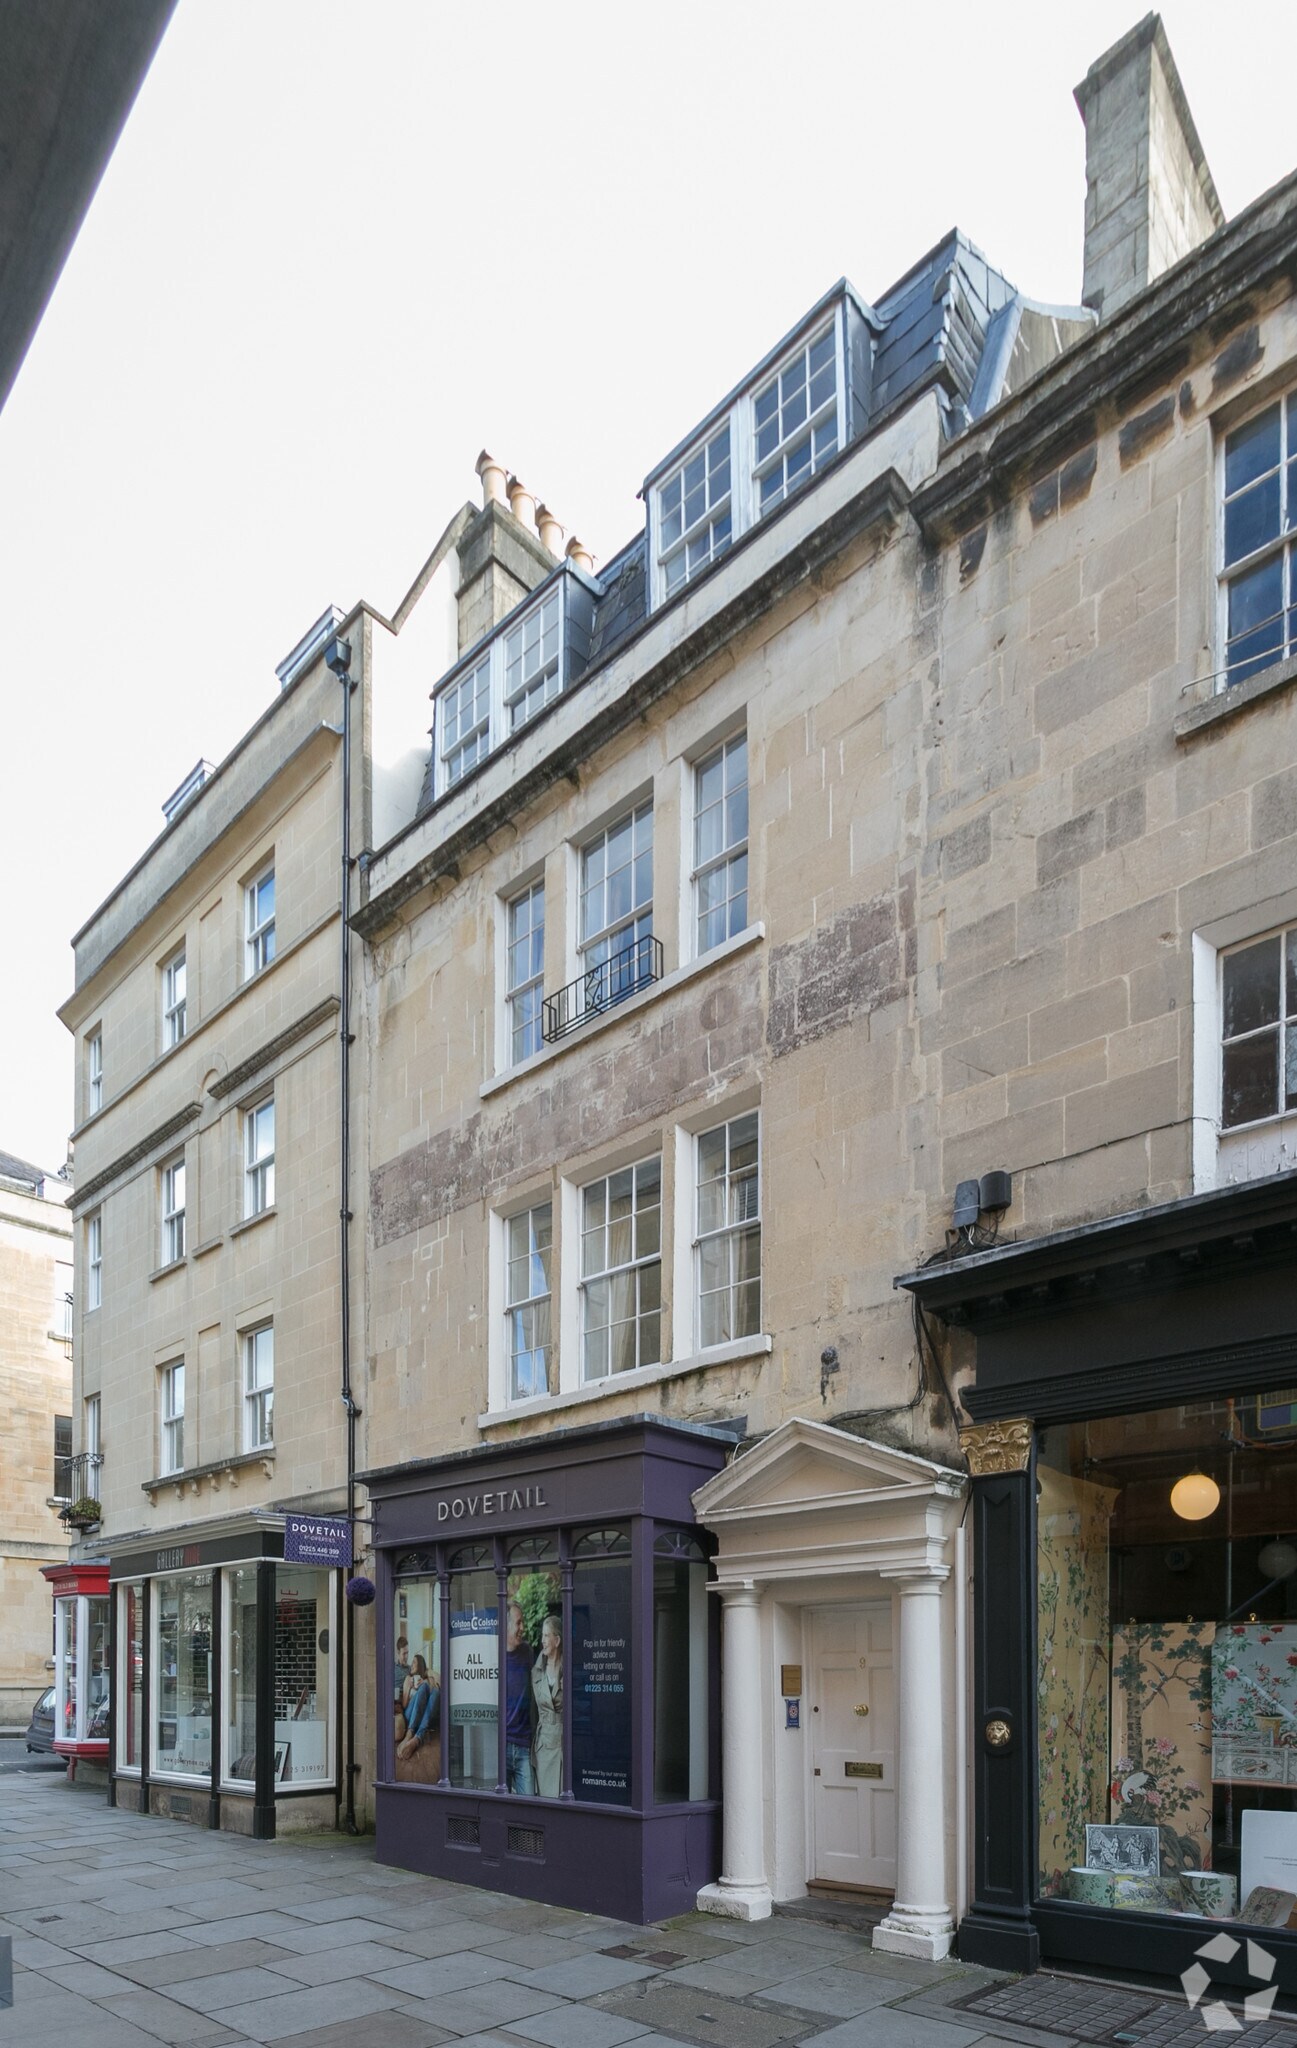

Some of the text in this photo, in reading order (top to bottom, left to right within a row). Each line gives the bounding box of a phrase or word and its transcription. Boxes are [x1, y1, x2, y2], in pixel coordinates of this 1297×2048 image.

[437, 1486, 546, 1521] DOVETAIL
[292, 1523, 346, 1538] DOVETAIL
[478, 1618, 498, 1626] Colsto
[583, 1639, 593, 1648] Pop
[594, 1639, 599, 1647] in
[607, 1638, 626, 1648] friendly
[466, 1653, 483, 1665] ALL
[592, 1650, 616, 1659] advice on
[583, 1662, 598, 1671] letting
[453, 1668, 499, 1681] ENQUIRIES
[595, 1673, 604, 1681] call
[584, 1684, 602, 1692] 01225
[453, 1709, 473, 1718] 01225
[582, 1778, 627, 1787] romans.co.uk
